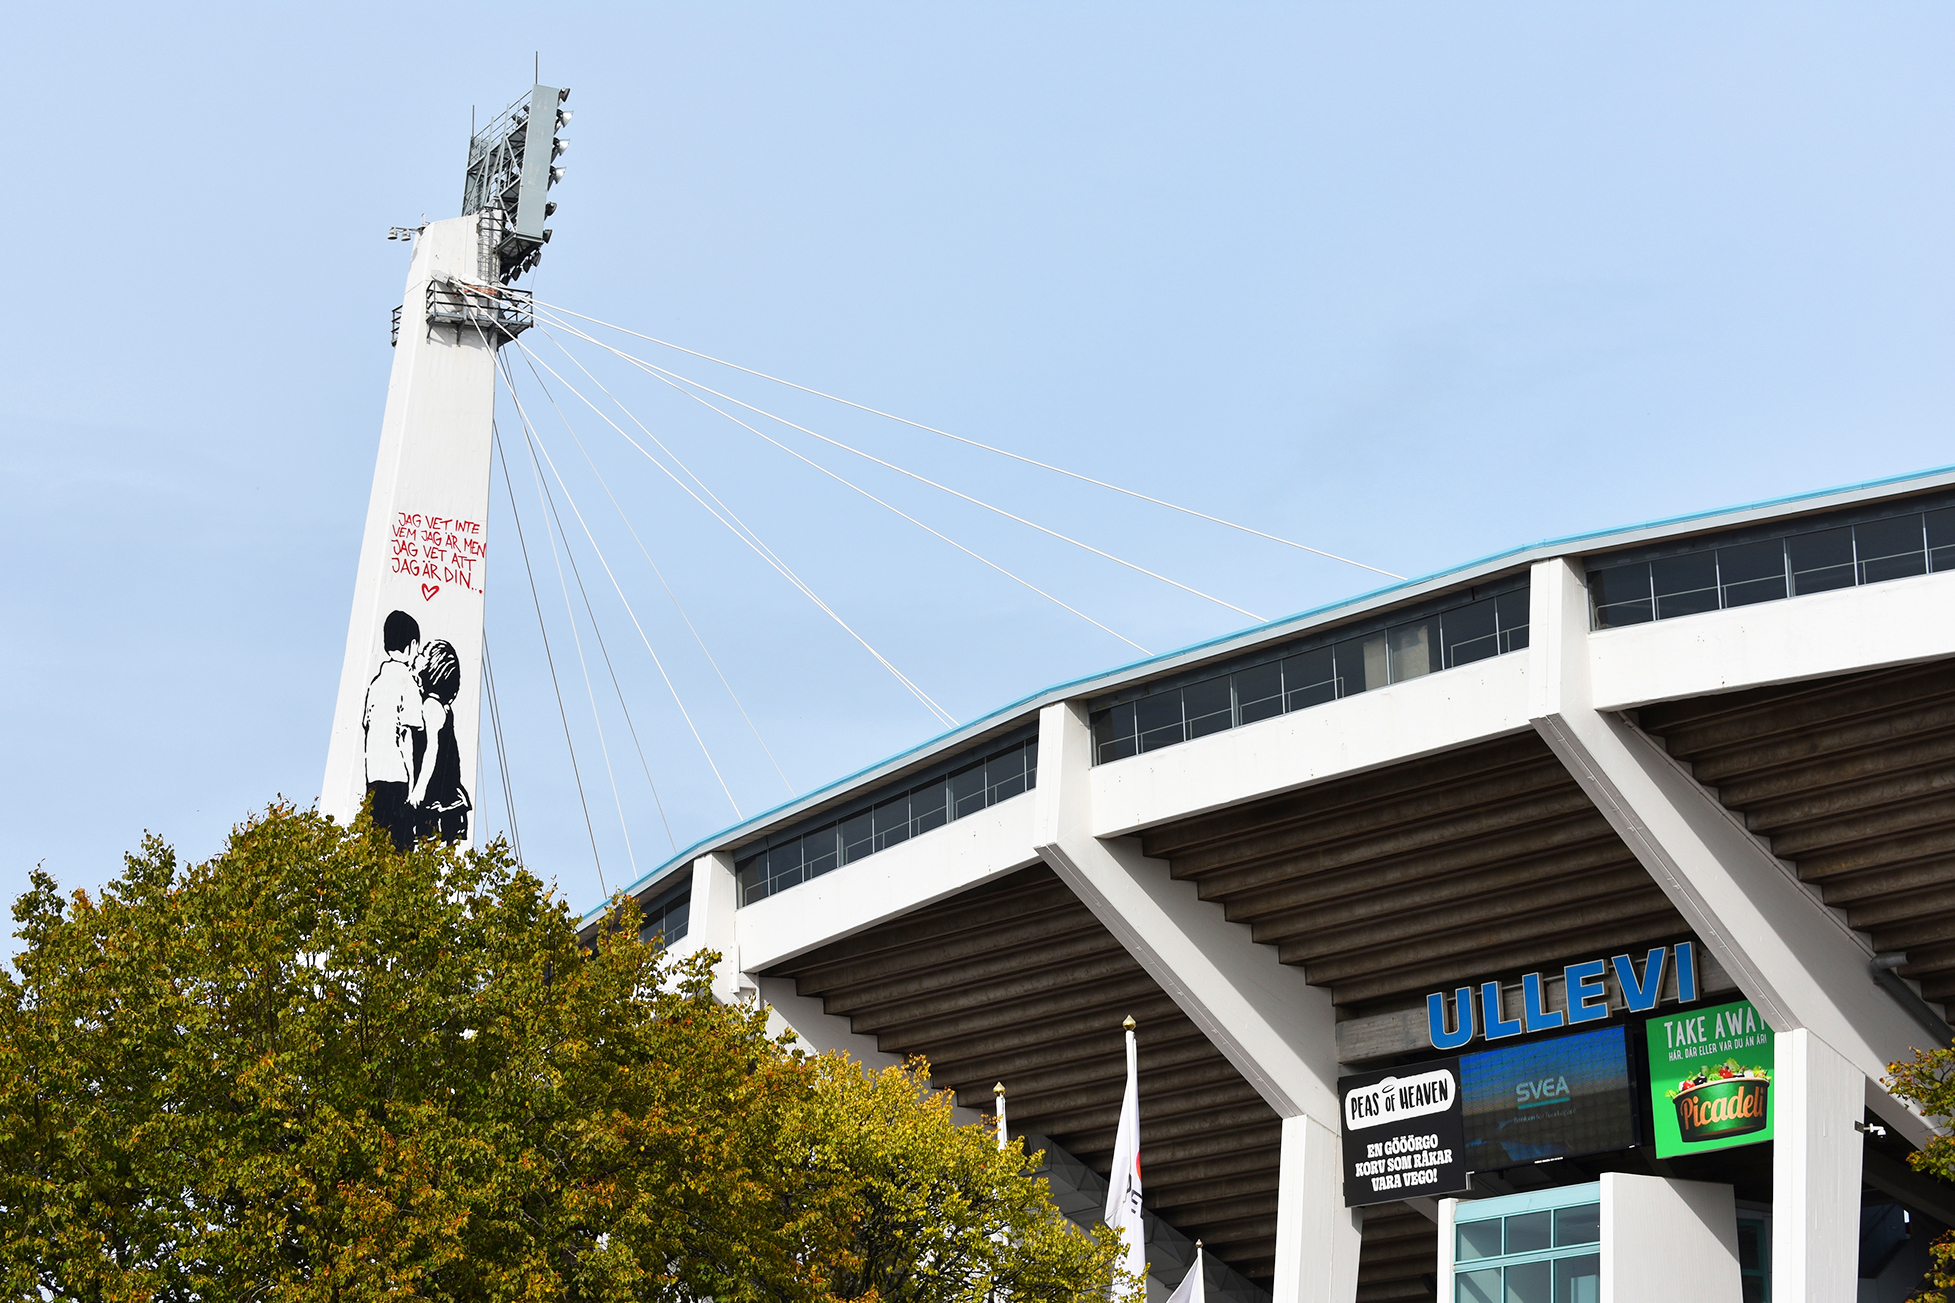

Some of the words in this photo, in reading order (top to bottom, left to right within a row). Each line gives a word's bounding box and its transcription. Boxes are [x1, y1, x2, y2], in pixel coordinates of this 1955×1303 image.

[398, 512, 421, 528] JAG
[425, 515, 453, 530] VET
[455, 520, 480, 534] INTE
[392, 524, 416, 540] VEM
[421, 530, 442, 546] JAG
[445, 532, 461, 553] ÄR
[464, 538, 486, 558] MEN
[391, 539, 418, 557] JAG
[423, 545, 447, 562] VET
[451, 552, 477, 572] ATT
[391, 557, 420, 577] JAG
[422, 560, 441, 581] ÄR
[1426, 941, 1699, 1050] ULLEVI
[1664, 1016, 1707, 1048] TAKE
[1699, 1044, 1718, 1056] ELLER
[1719, 1038, 1733, 1052] VAR
[1734, 1037, 1744, 1049] DU
[1351, 1092, 1380, 1120] PEAS
[1385, 1094, 1396, 1112] OF
[1399, 1078, 1449, 1109] HEAVEN
[1516, 1076, 1570, 1102] SVEA
[1680, 1086, 1764, 1130] Picadeli
[1367, 1143, 1383, 1158] EN
[1384, 1134, 1438, 1155] GÖÖÖRGO
[1355, 1159, 1386, 1177] KORV
[1387, 1155, 1412, 1172] SOM
[1413, 1149, 1453, 1168] RÅKAR
[1371, 1174, 1402, 1191] VARA
[1403, 1168, 1438, 1186] VEGO!
